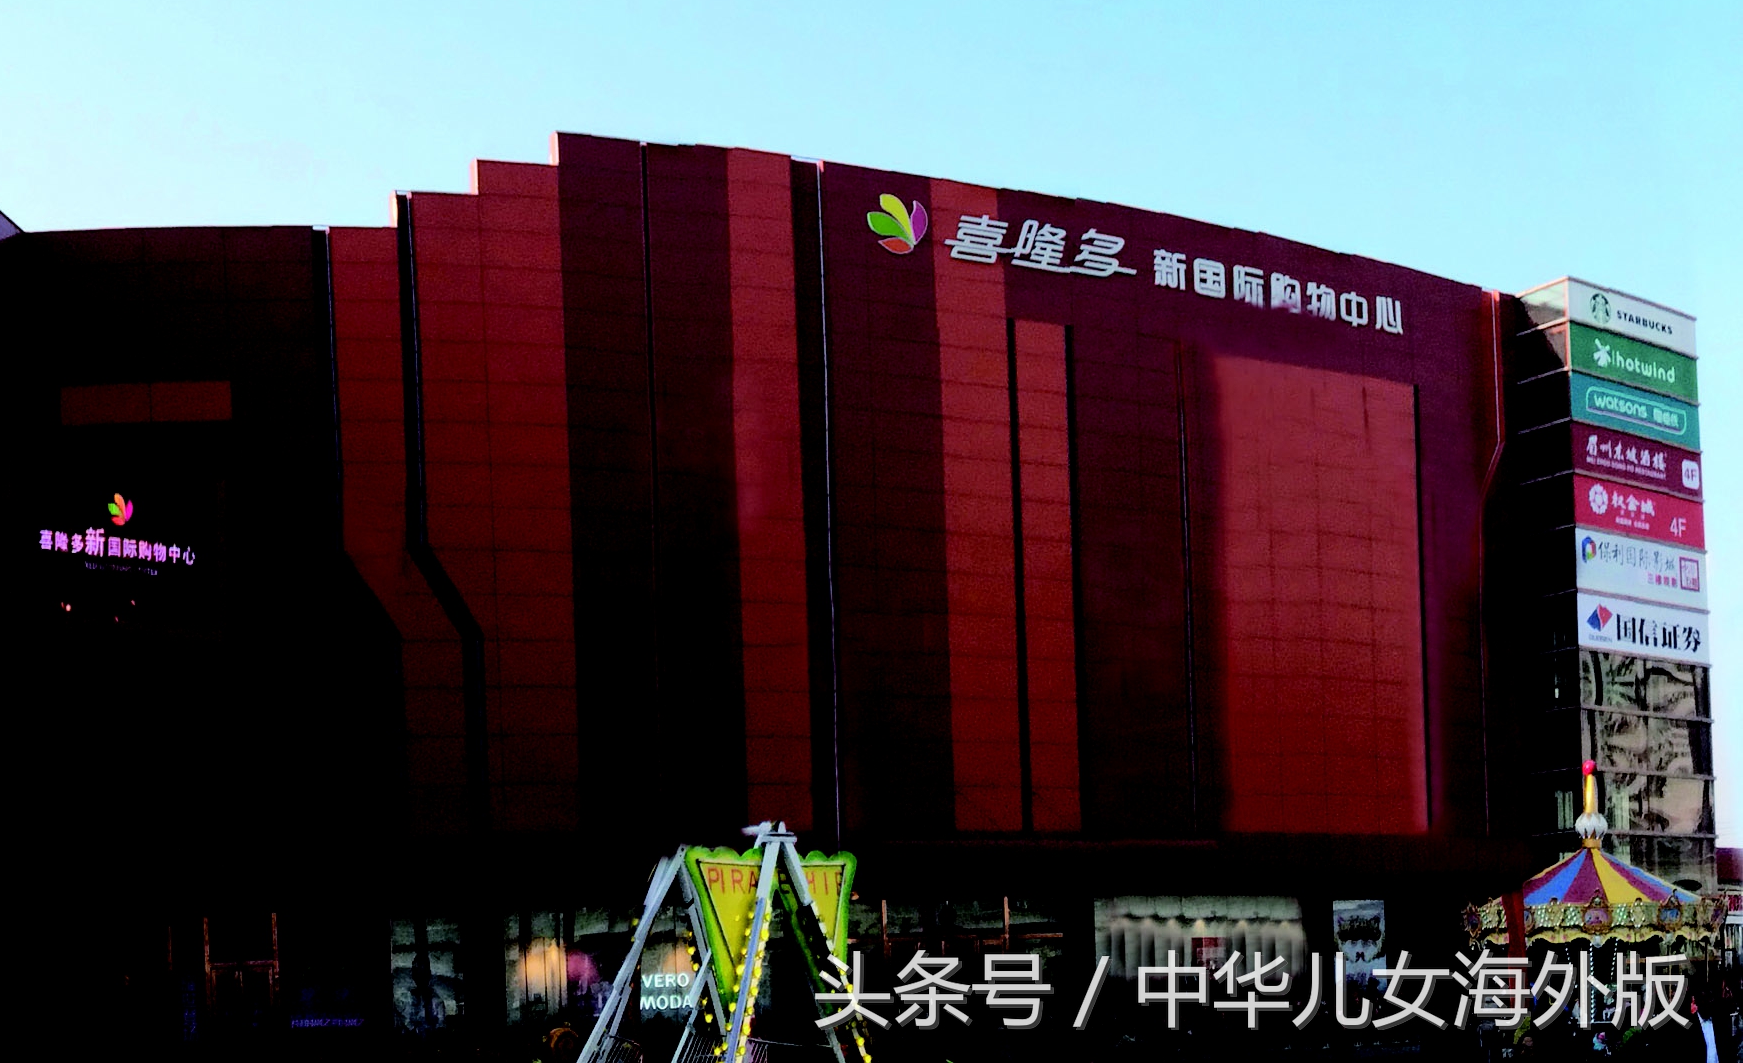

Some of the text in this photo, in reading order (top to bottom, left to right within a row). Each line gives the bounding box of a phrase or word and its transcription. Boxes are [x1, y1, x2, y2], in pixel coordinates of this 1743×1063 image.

[944, 213, 1404, 335] 喜隆多 新国际购物中心
[1616, 309, 1674, 335] STARBUCKS
[1615, 350, 1675, 384] hotwind
[1684, 467, 1698, 482] 4F
[1669, 517, 1687, 538] 4F
[39, 526, 196, 566] 喜隆多新国际购物中心
[1598, 541, 1675, 572] 保利国际影城
[1616, 613, 1702, 653] 国信证券
[707, 866, 790, 895] PIRAE
[641, 972, 690, 988] VERO
[639, 994, 693, 1011] MODA
